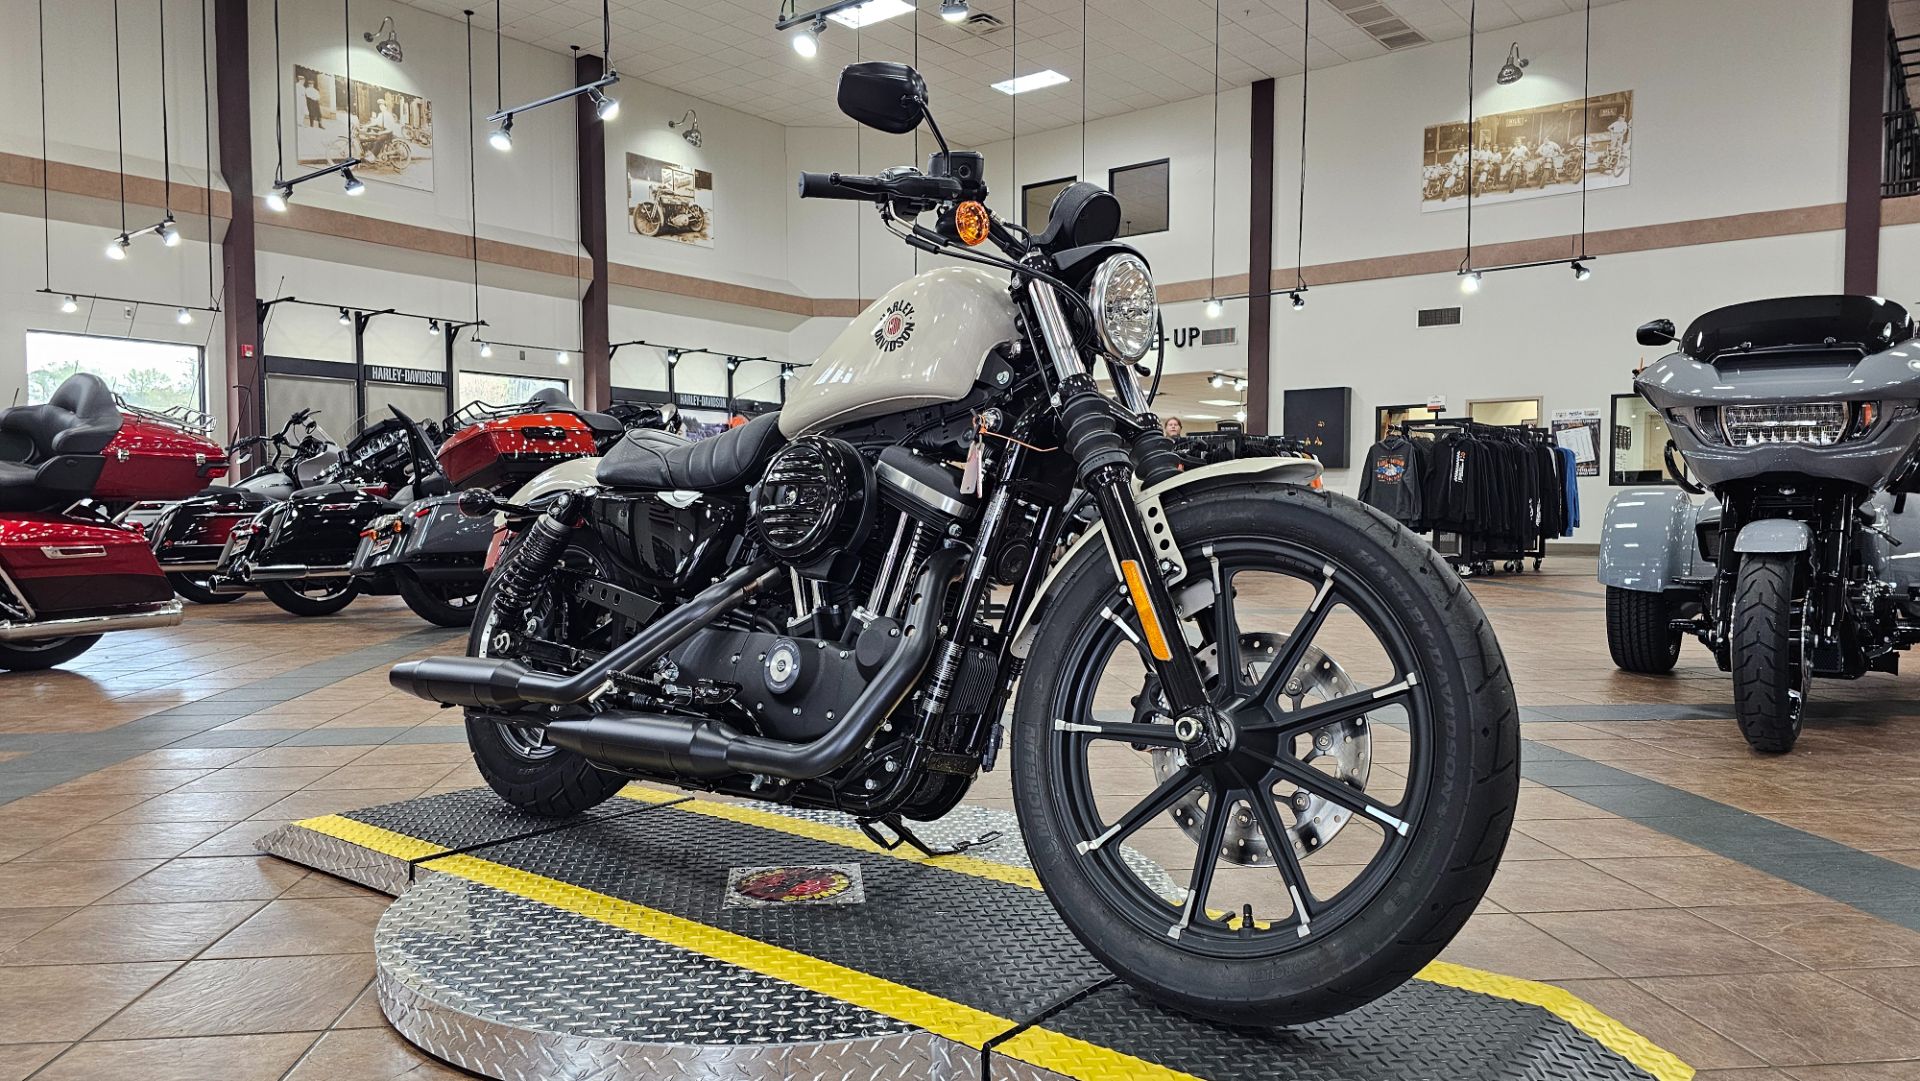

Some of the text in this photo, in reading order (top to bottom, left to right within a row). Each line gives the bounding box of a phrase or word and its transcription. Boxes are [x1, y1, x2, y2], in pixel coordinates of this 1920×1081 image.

[874, 322, 915, 352] DAVIDSON
[372, 366, 442, 385] HARLEY-DAVIDSON
[680, 394, 726, 408] HARLEY-DAVIDSON
[1024, 725, 1050, 837] MICHELIN
